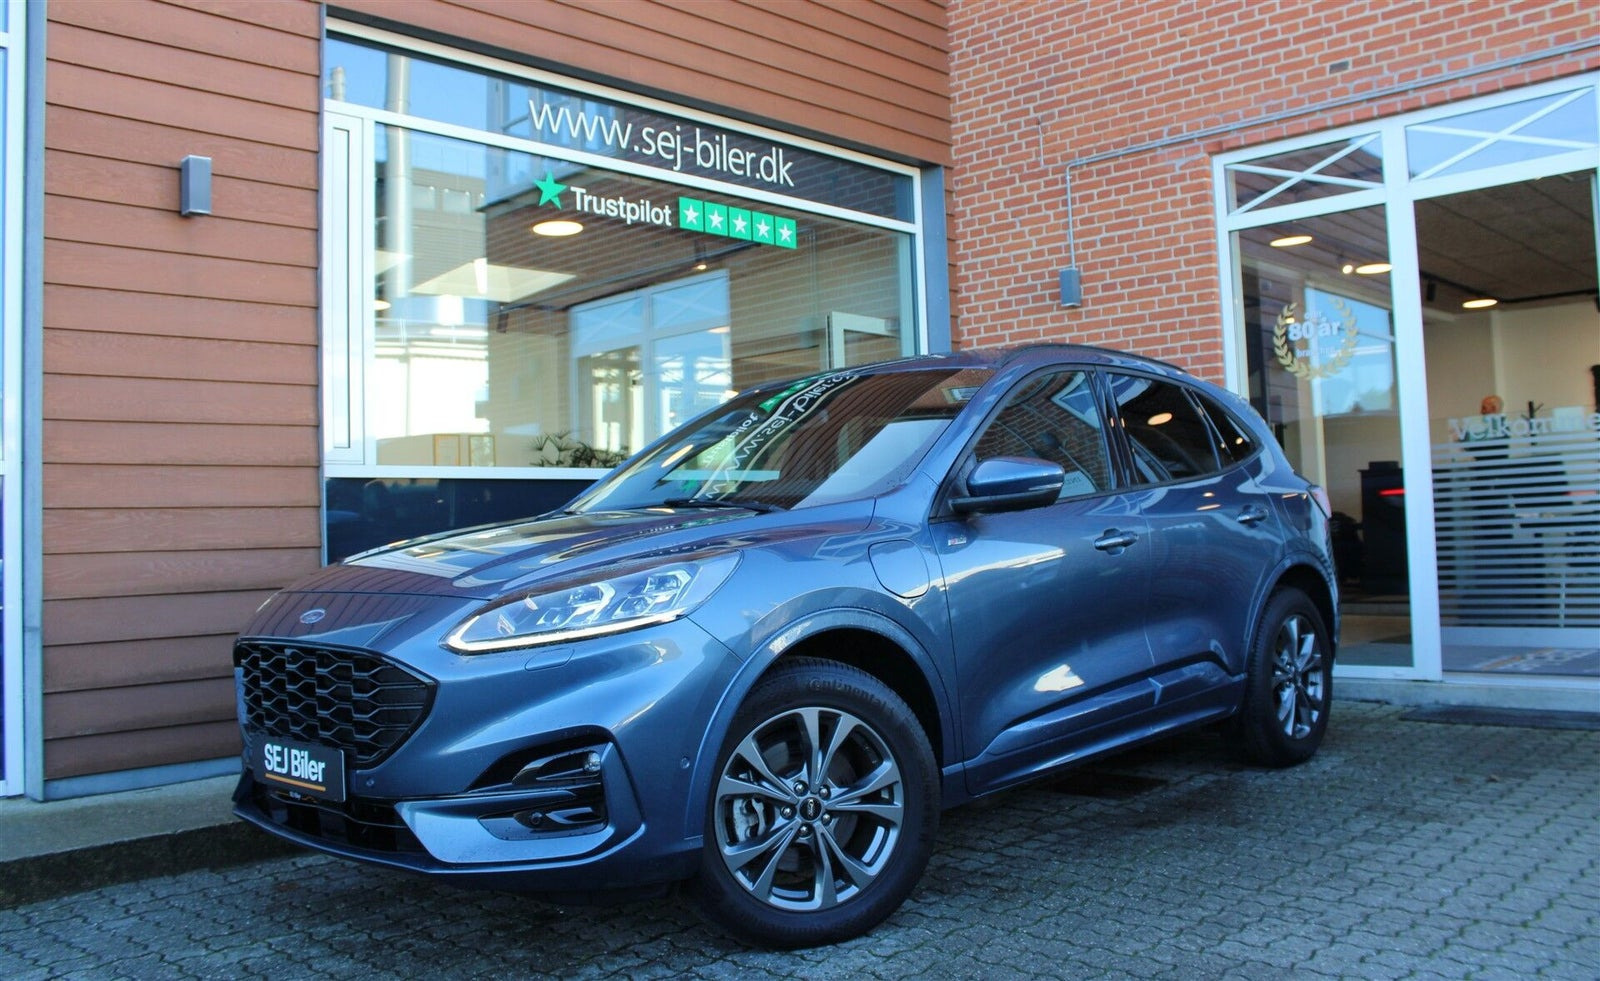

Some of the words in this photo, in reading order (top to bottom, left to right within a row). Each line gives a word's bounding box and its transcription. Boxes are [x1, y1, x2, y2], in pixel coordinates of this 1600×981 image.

[529, 100, 795, 187] www.sej-biler.dk
[570, 186, 672, 226] Trustpilot
[1288, 320, 1314, 341] 80
[264, 743, 289, 774] SEJ
[290, 748, 326, 783] Biler
